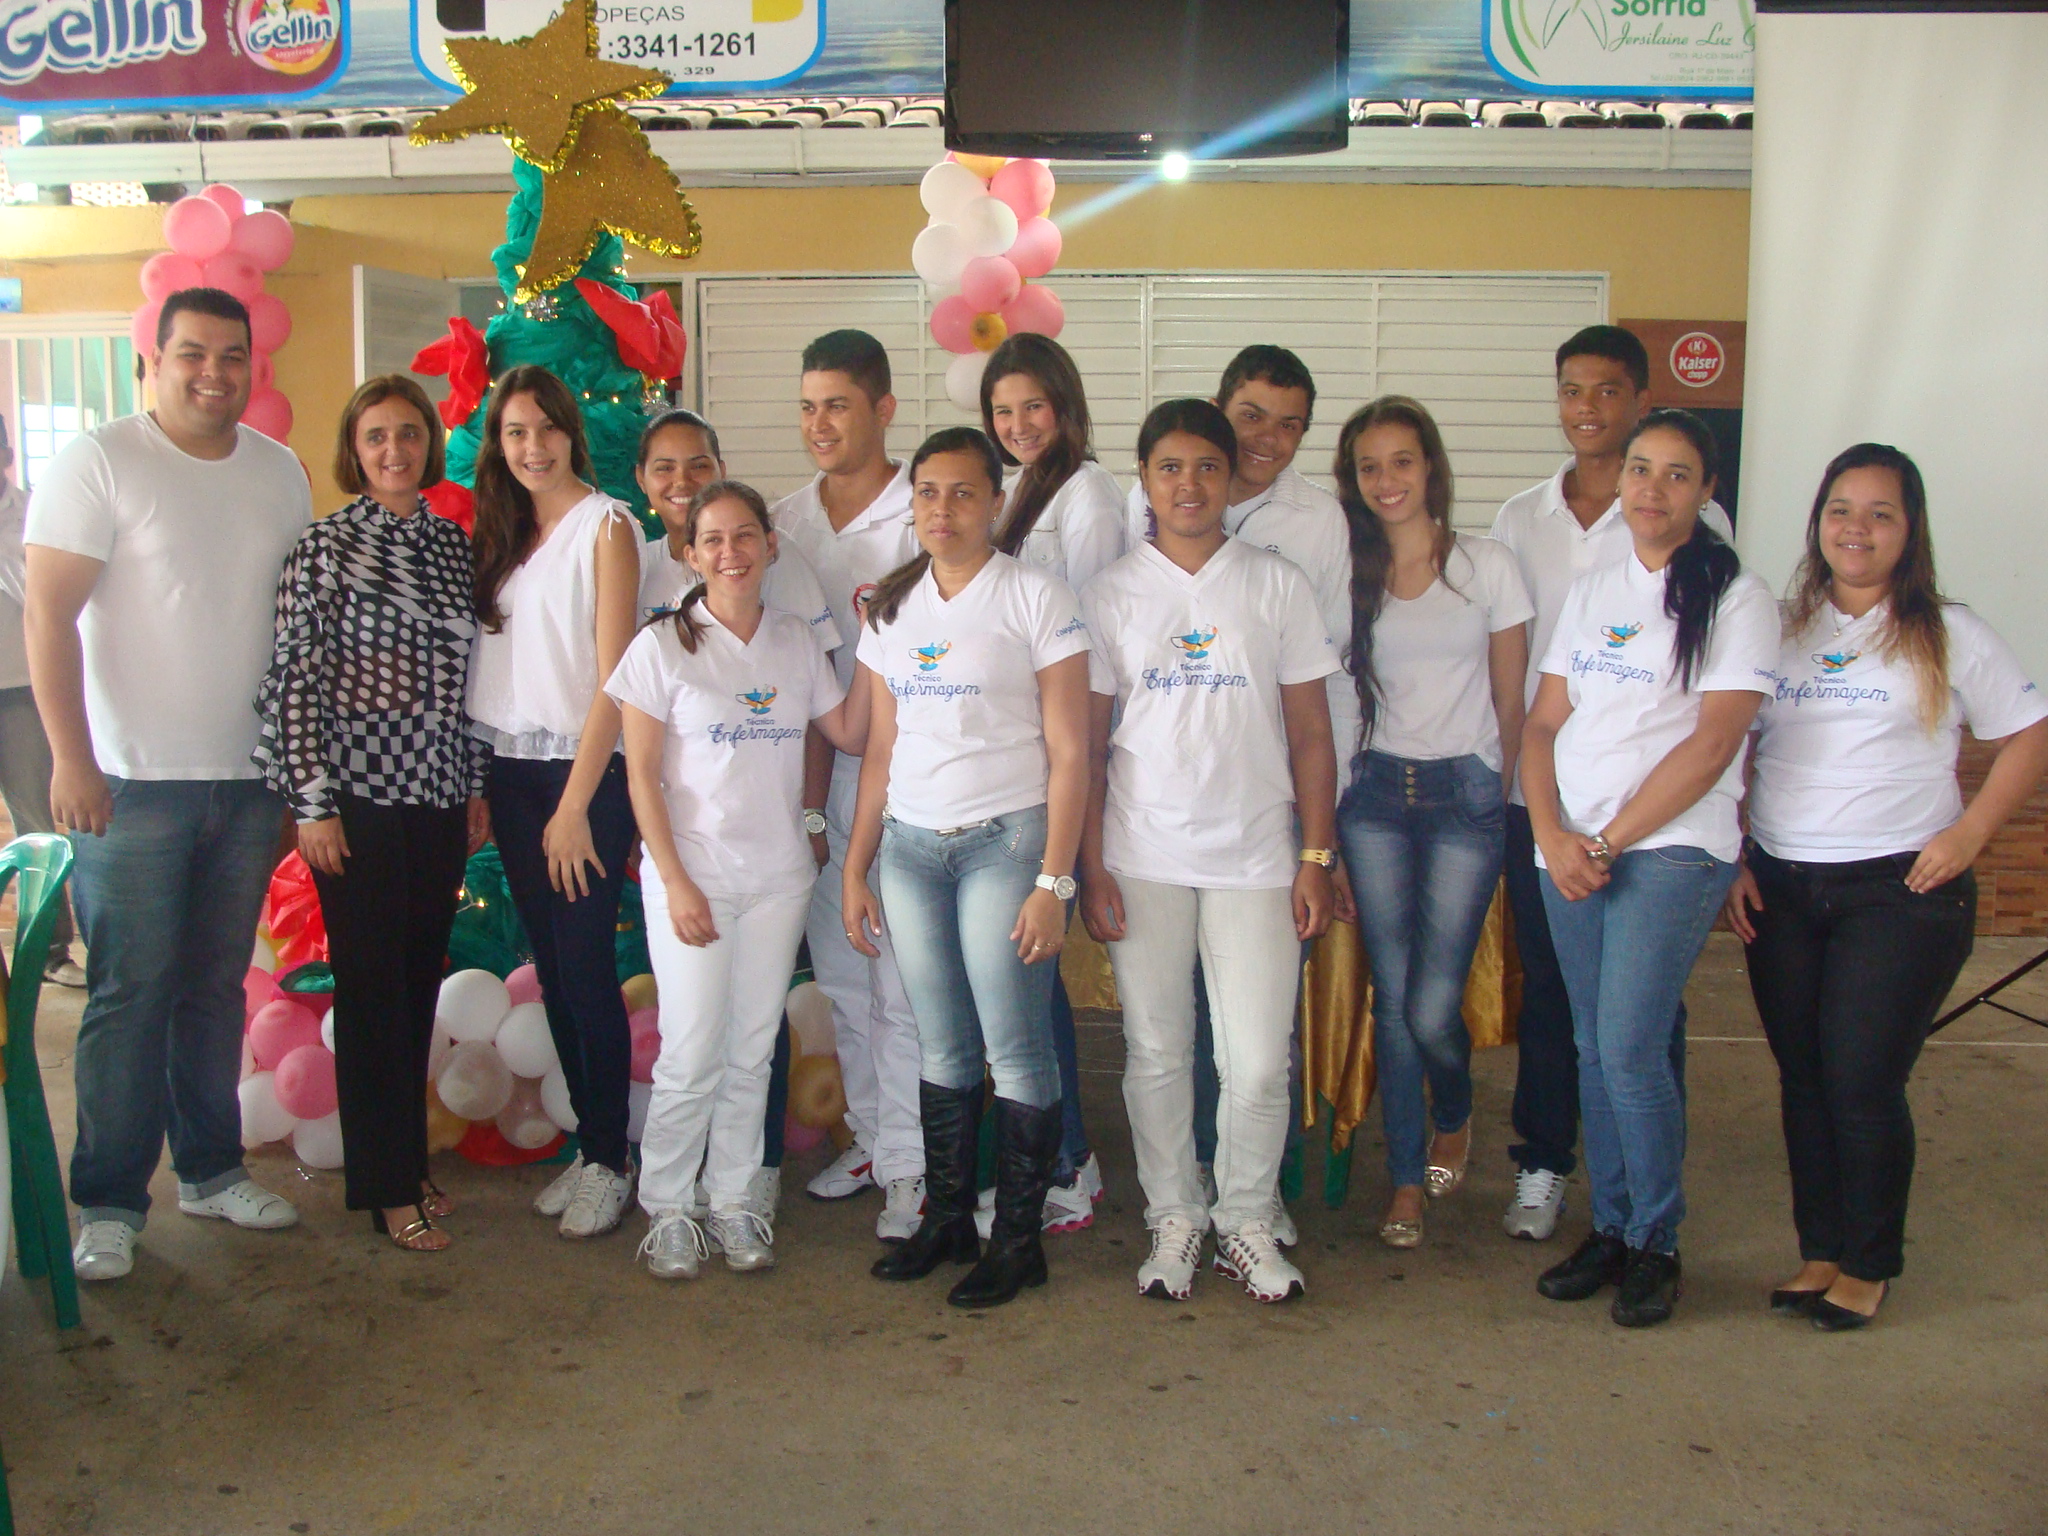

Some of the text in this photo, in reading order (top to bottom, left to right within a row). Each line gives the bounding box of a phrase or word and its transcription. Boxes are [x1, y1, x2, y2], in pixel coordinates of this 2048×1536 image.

[548, 6, 685, 25] AOPEÇAS
[0, 0, 206, 85] Gellin
[247, 10, 335, 53] Gellin
[1608, 21, 1689, 52] Jersilaine
[1696, 22, 1734, 46] Luz
[684, 66, 715, 76] 329
[1678, 356, 1718, 370] Kaiser
[1142, 668, 1248, 695] Enfermagem
[1776, 677, 1890, 707] Enfermagem
[707, 722, 803, 748] Enfermagem
